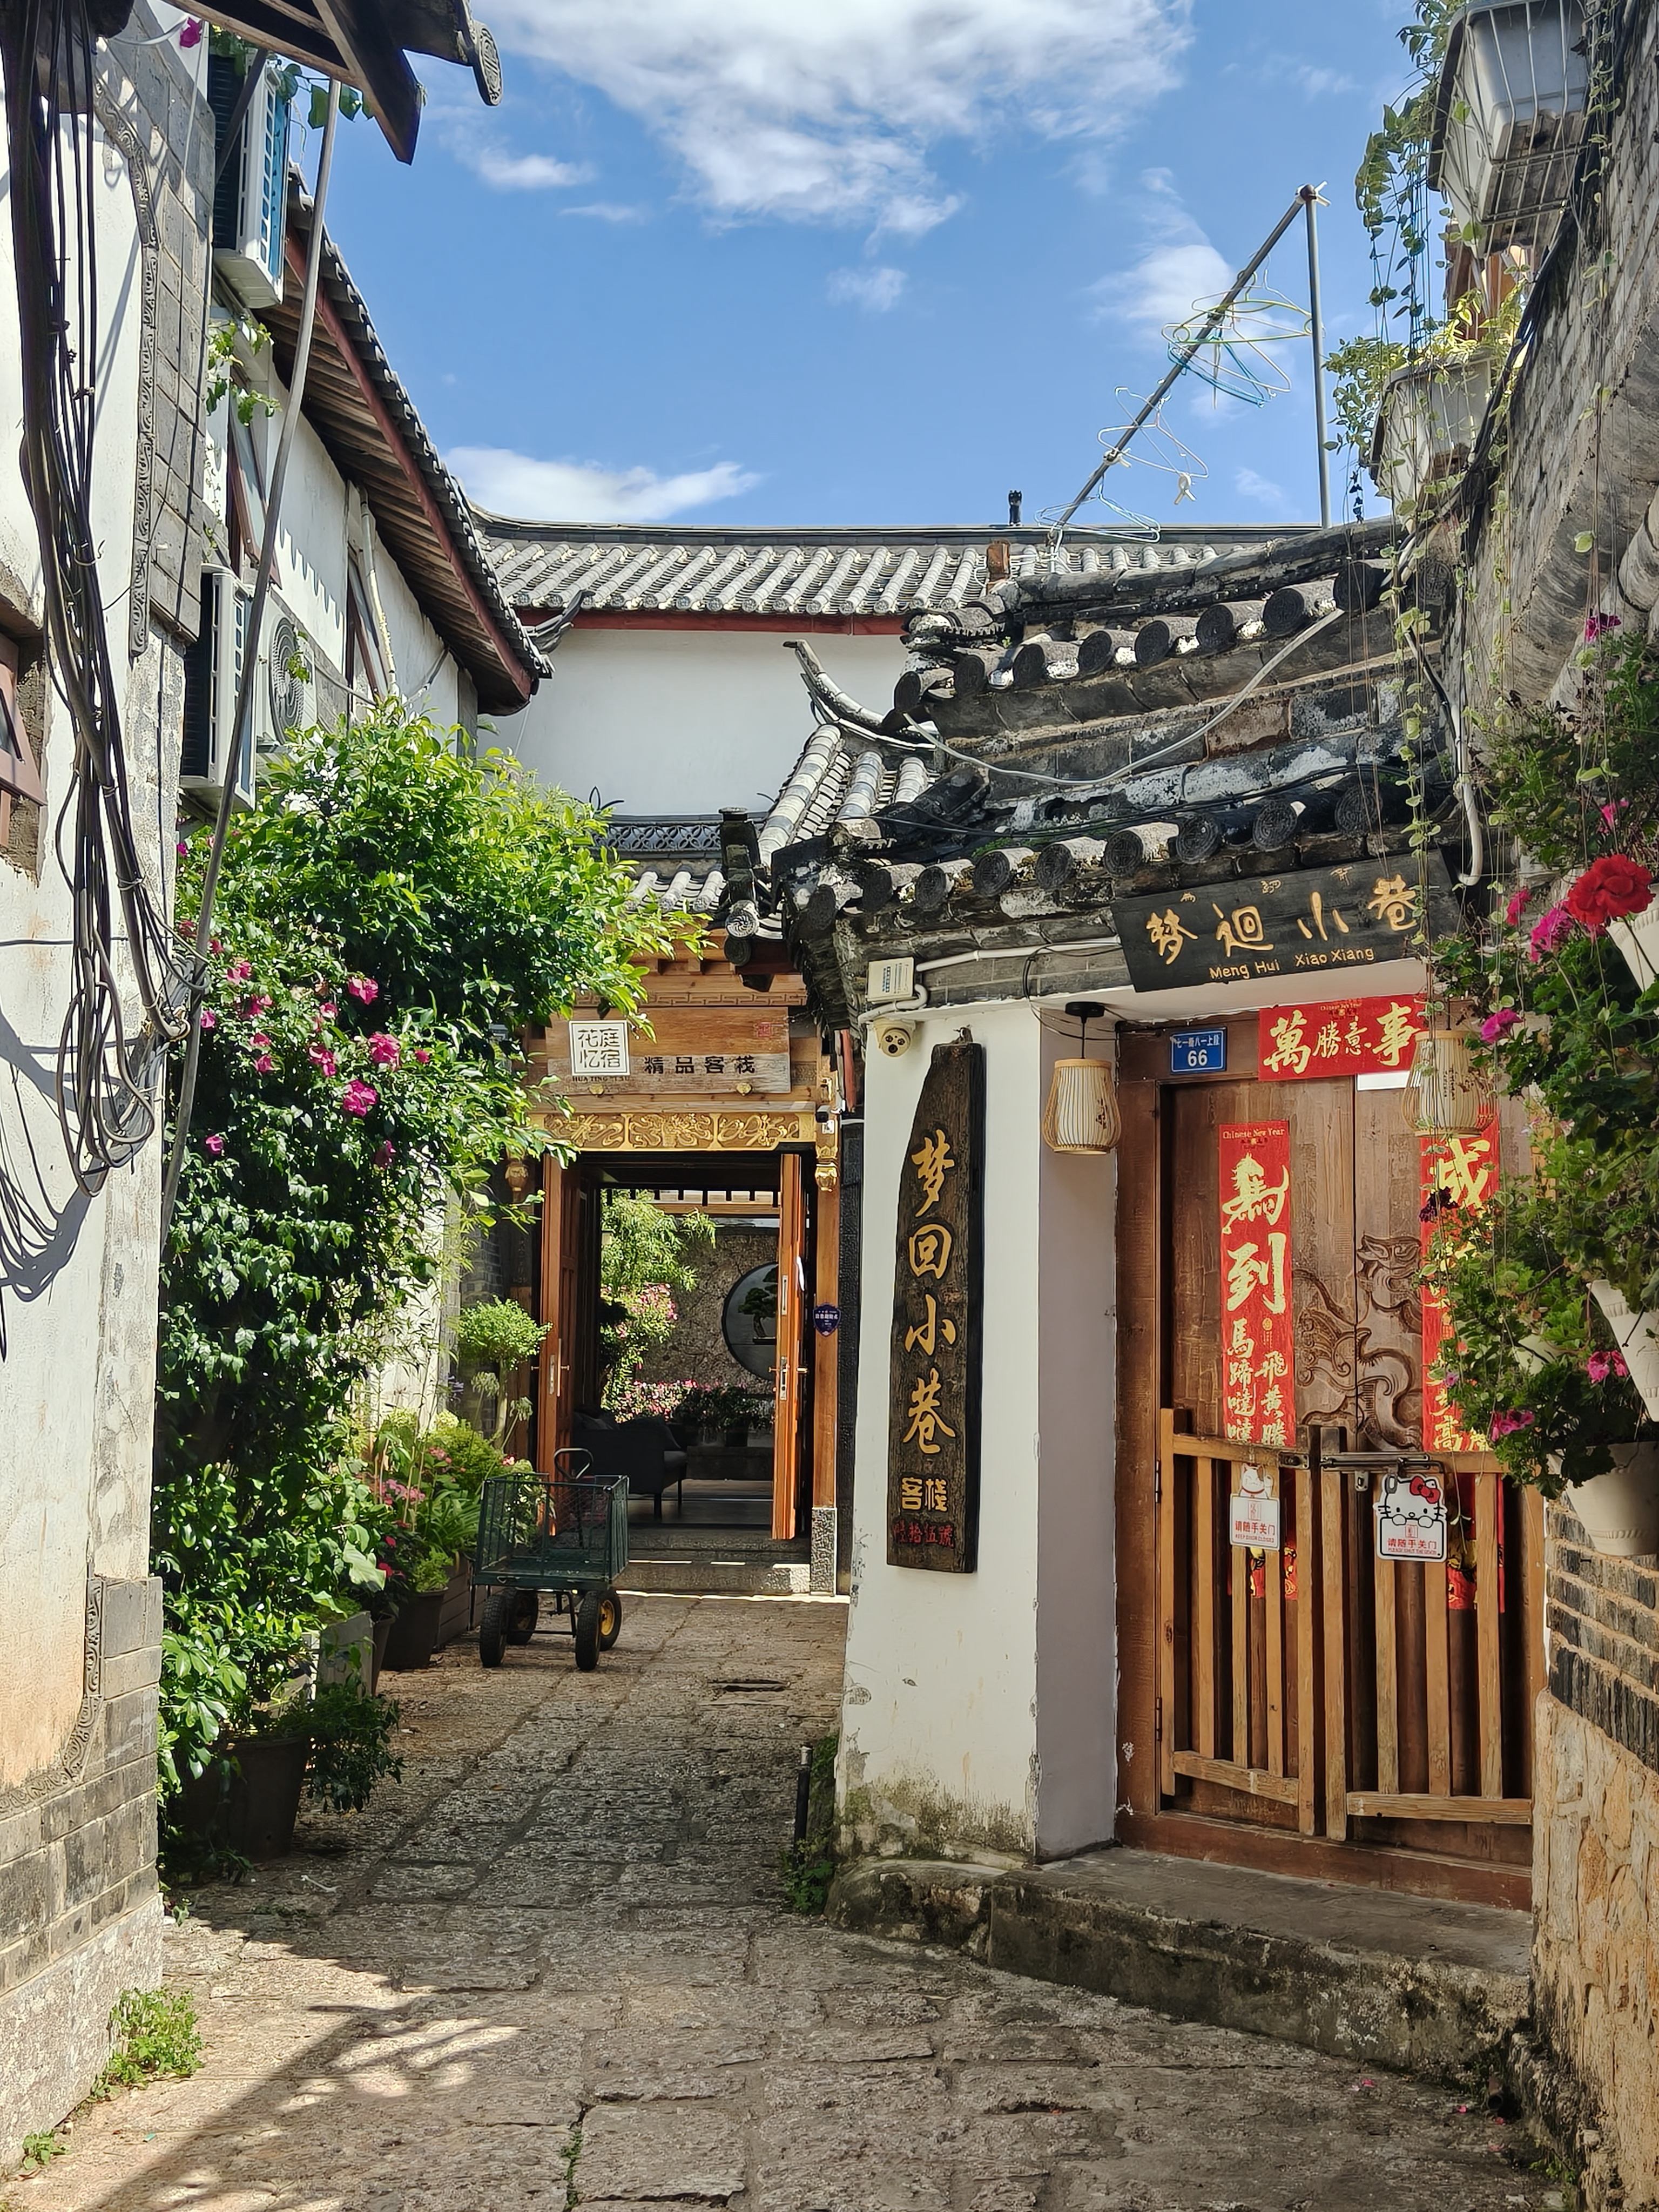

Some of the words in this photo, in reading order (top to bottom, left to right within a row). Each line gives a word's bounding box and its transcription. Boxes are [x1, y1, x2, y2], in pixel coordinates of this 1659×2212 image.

[1209, 965, 1250, 979] Meng
[1255, 959, 1280, 974] Hui
[1295, 953, 1327, 967] Xiao
[1331, 948, 1374, 962] Xiang
[644, 1055, 756, 1074] 精品客栈
[1188, 1049, 1208, 1067] 66
[1267, 1127, 1285, 1136] Year
[903, 1129, 956, 1454] 梦回小巷
[1235, 1520, 1275, 1536] 请随手关门
[1388, 1538, 1437, 1549] 请随手关门
